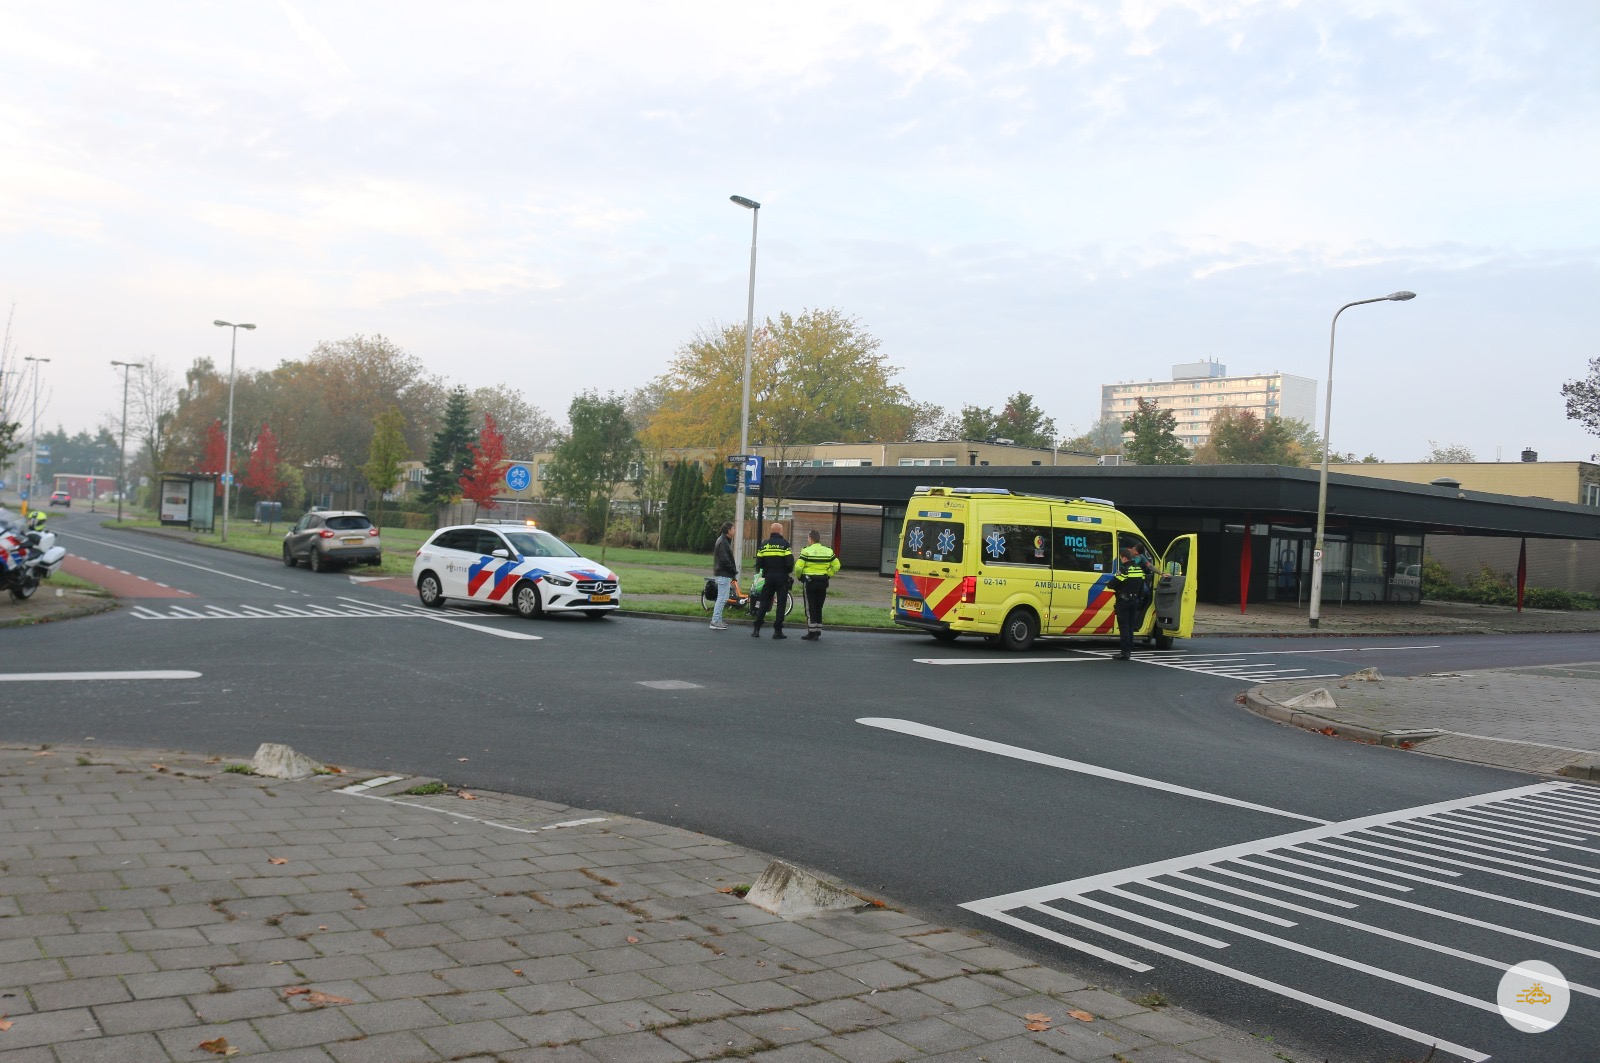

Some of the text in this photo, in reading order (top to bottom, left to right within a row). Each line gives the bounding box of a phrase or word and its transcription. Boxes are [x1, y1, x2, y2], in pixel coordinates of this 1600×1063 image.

[1064, 535, 1087, 548] mcl
[983, 578, 1007, 586] 02-141
[1034, 580, 1082, 591] AMBULANCE
